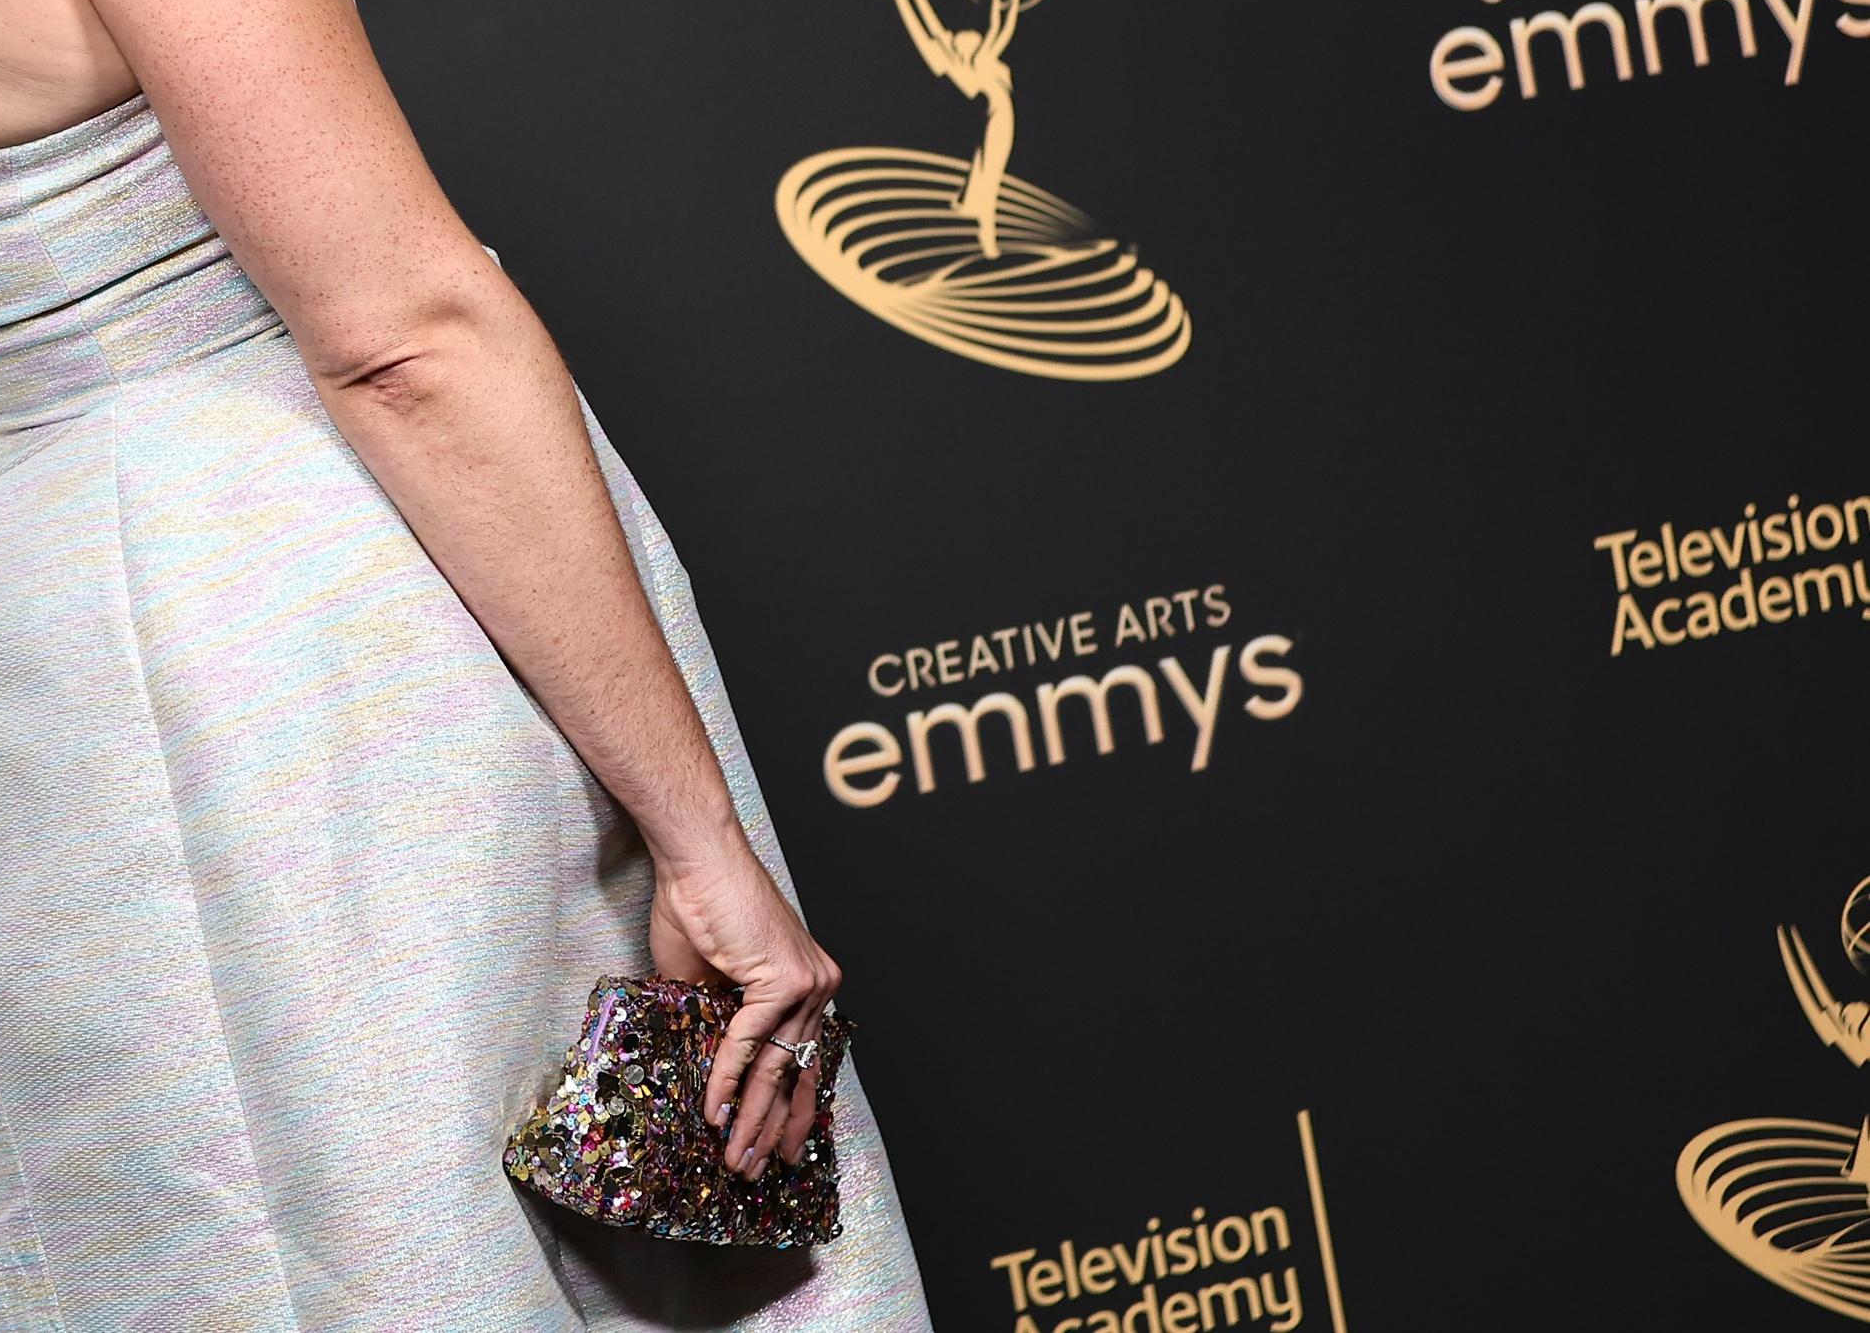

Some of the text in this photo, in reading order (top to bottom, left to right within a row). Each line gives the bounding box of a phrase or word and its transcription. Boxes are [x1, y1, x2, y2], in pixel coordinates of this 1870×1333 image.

[869, 585, 1230, 696] CREATIVE ARTS
[824, 635, 1302, 807] emmys
[991, 1207, 1290, 1310] Television
